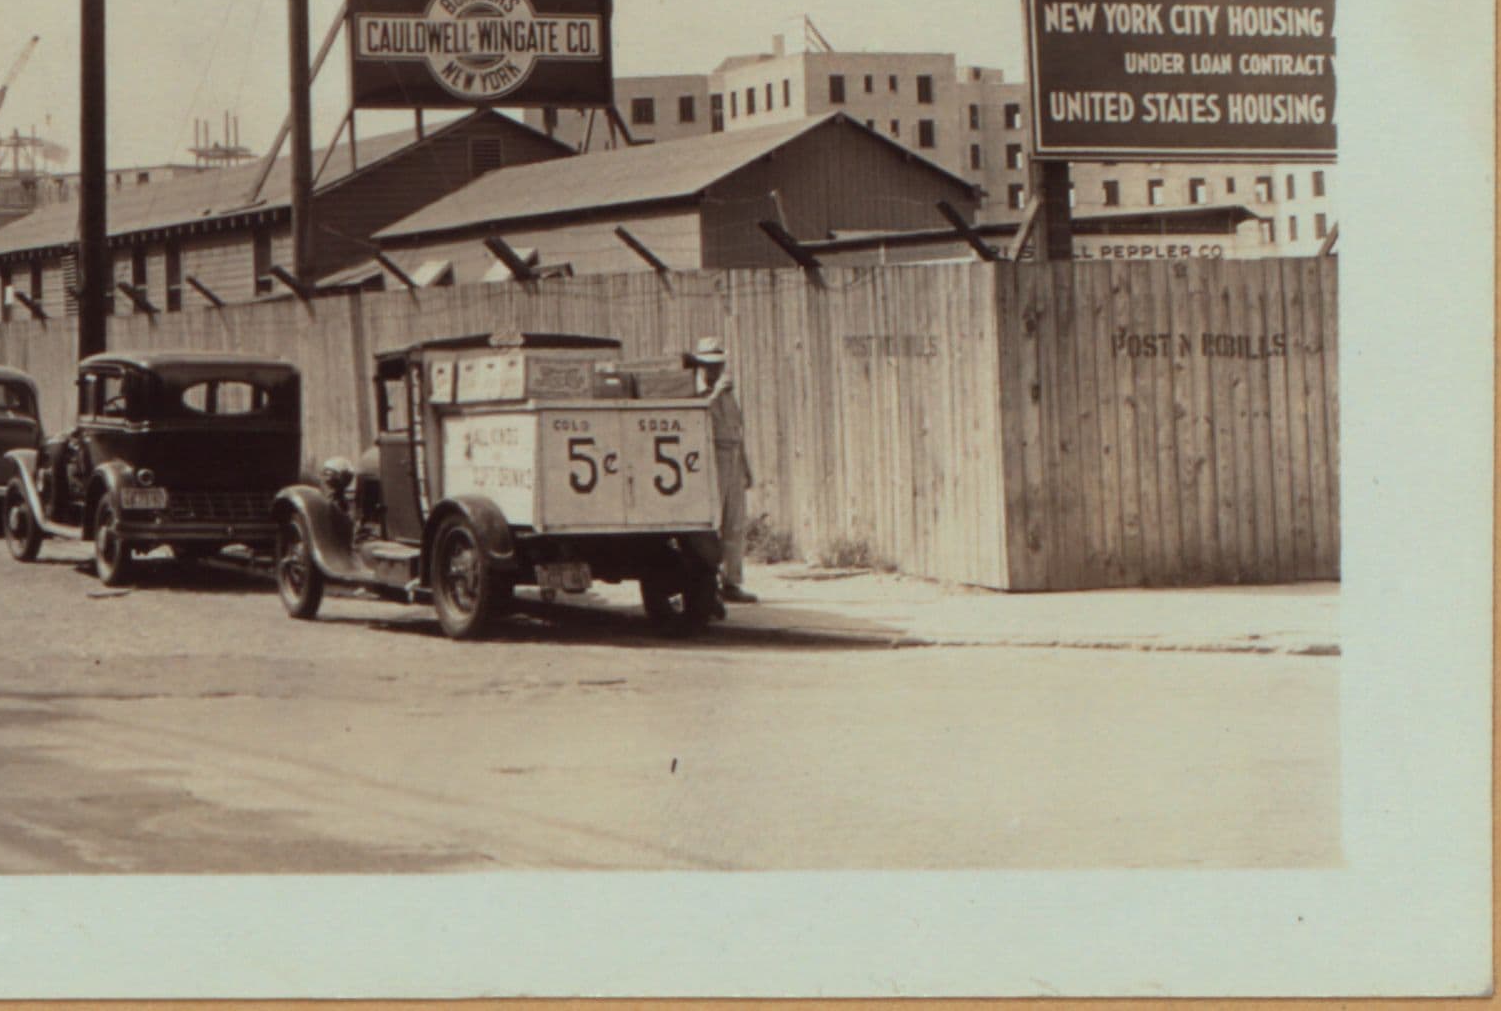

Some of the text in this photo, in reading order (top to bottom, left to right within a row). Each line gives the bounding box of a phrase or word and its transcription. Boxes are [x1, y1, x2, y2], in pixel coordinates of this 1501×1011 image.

[1044, 3, 1096, 34] NEW
[1103, 3, 1163, 35] YORK
[1170, 5, 1220, 36] CITY
[1227, 6, 1324, 38] HOUSING
[566, 22, 596, 54] CO.
[441, 60, 521, 93] NEW YORK
[1124, 53, 1185, 74] UNDER
[1191, 54, 1232, 75] LOAN
[1239, 55, 1325, 76] CONTRACT
[1050, 92, 1327, 125] UNITED STATES HOUSING
[1101, 244, 1192, 259] PEPPLER
